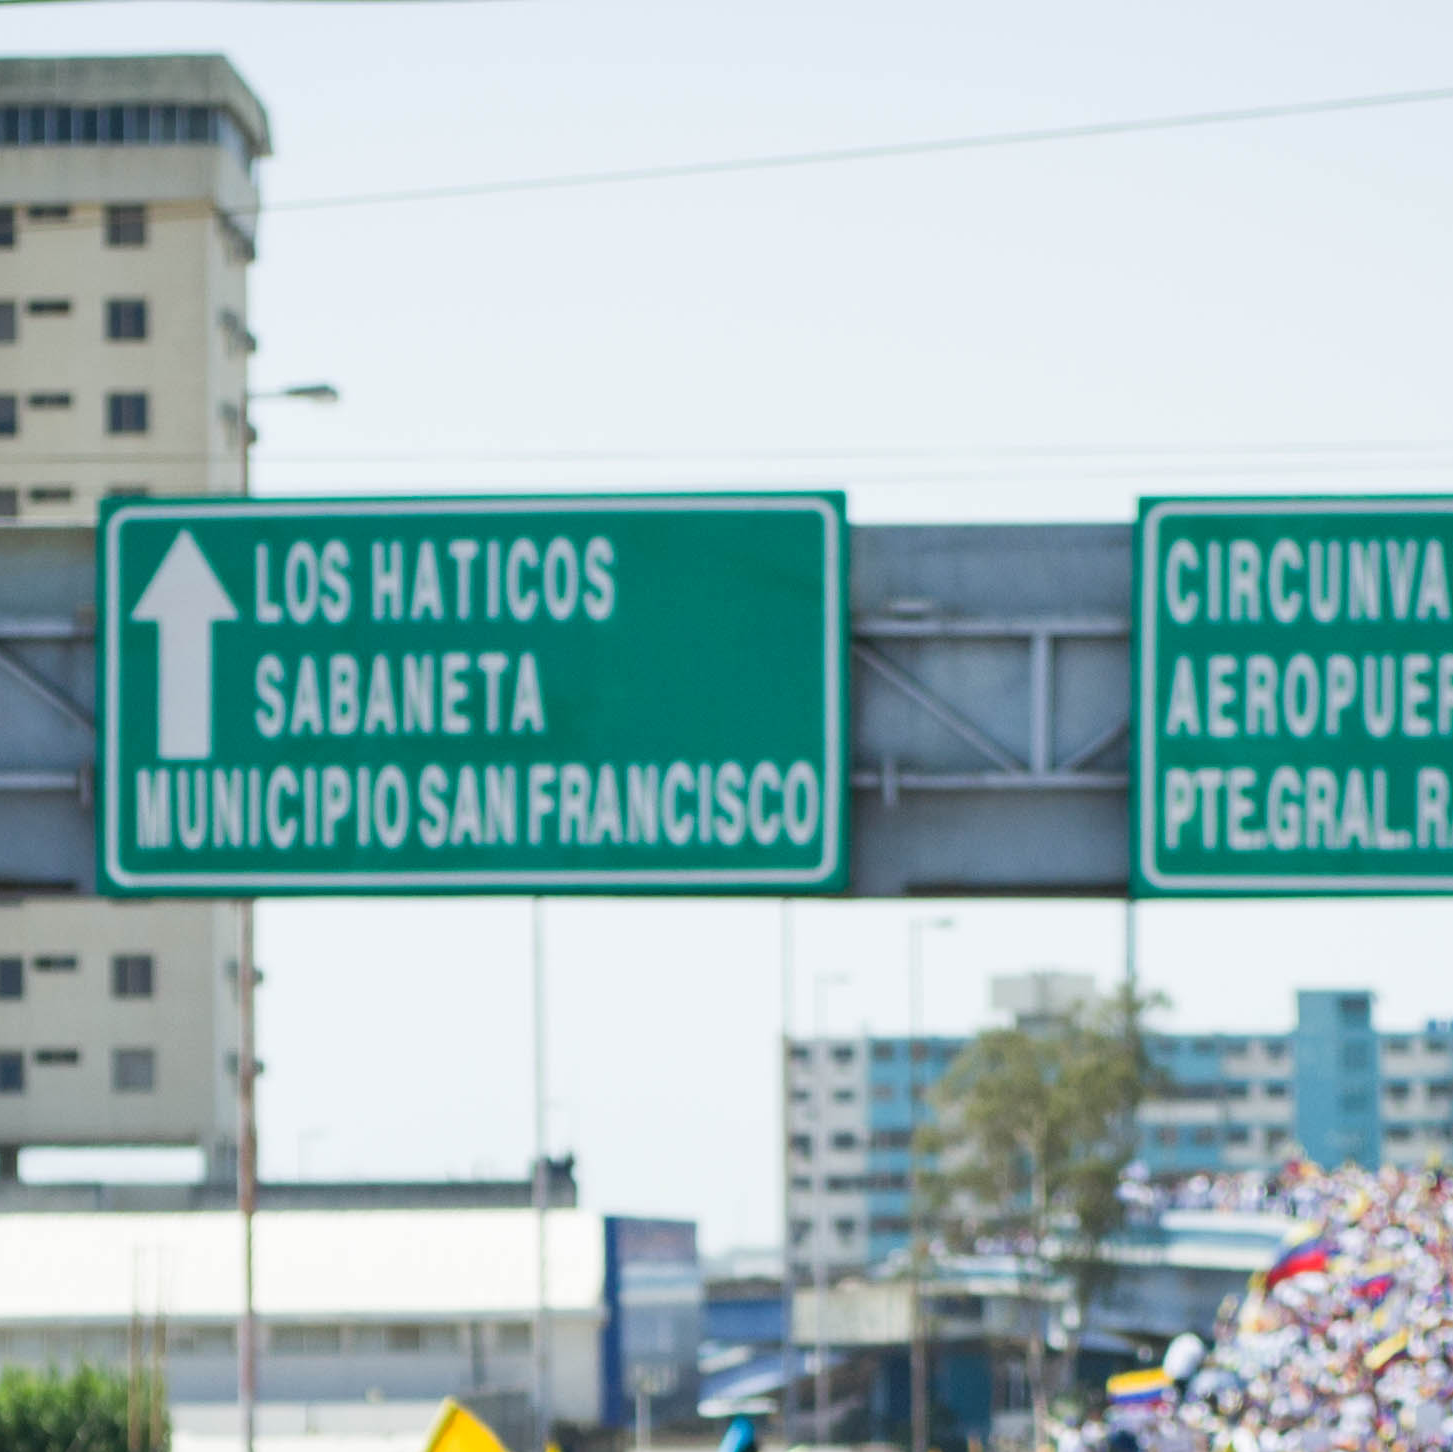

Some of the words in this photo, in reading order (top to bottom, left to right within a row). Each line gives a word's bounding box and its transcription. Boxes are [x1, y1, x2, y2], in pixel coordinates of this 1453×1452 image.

[255, 540, 351, 623] LOS
[372, 537, 615, 621] HATICOS
[255, 652, 545, 738] SABANETA
[136, 765, 410, 849] MUNICIPIO
[418, 763, 518, 848] SAN
[527, 761, 820, 846] FRANCISCO
